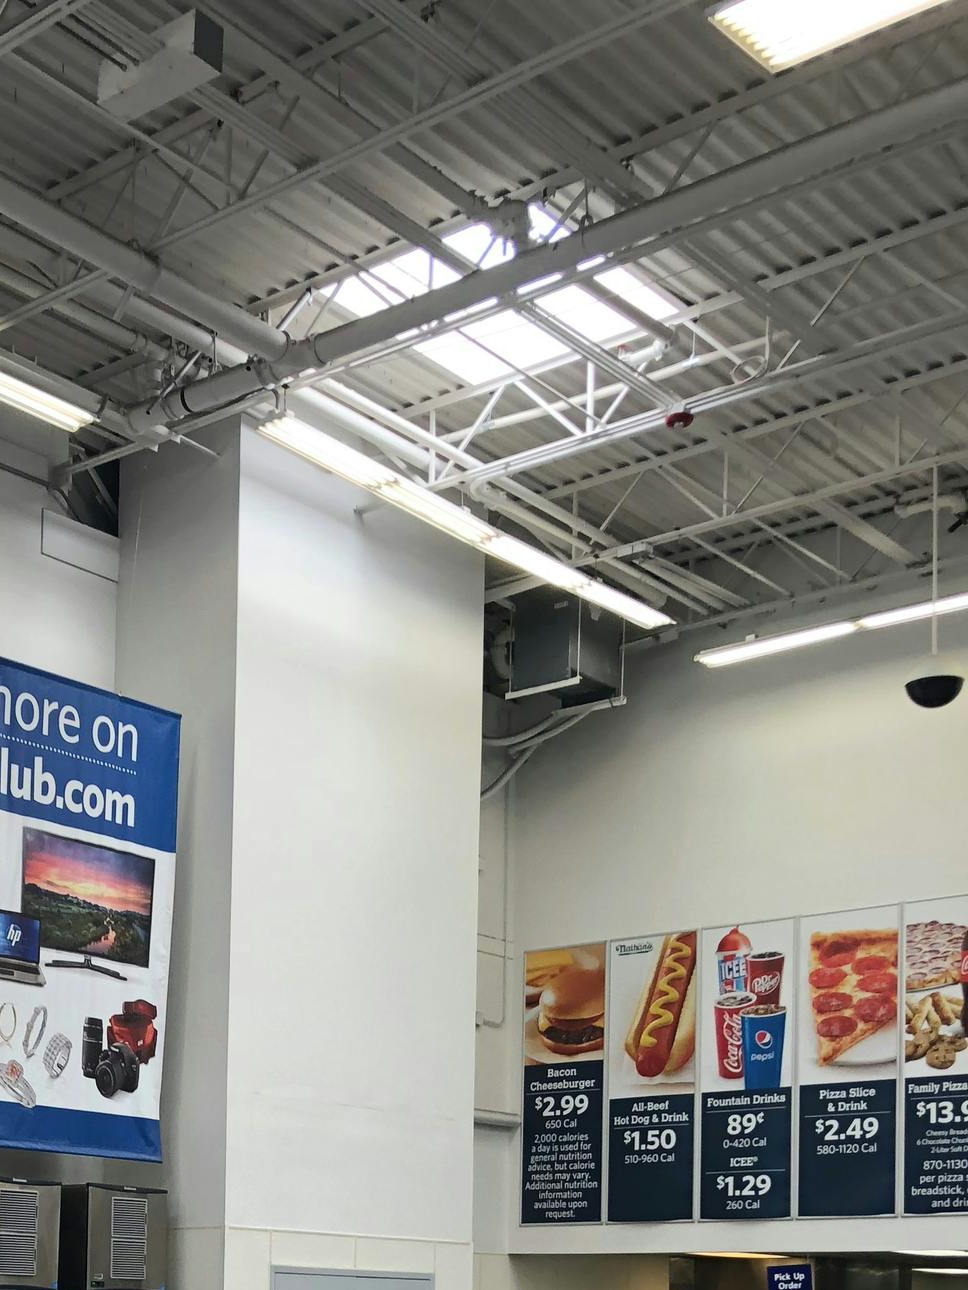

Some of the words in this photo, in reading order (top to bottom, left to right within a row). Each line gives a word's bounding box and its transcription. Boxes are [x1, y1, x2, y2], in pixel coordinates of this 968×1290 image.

[92, 715, 138, 762] on
[6, 924, 22, 947] hp
[750, 1051, 775, 1062] pepsi
[547, 1068, 577, 1078] Bacon
[530, 1078, 596, 1092] Cheeseburger
[908, 1082, 940, 1095] Family
[942, 1081, 968, 1092] Pizza
[819, 1089, 847, 1100] Pizza
[848, 1086, 876, 1098] Slice
[535, 1095, 589, 1117] $2.99
[632, 1101, 669, 1112] All-Beef
[707, 1094, 751, 1108] Fountain
[752, 1093, 786, 1105] Drinks
[827, 1102, 836, 1112] &
[837, 1100, 868, 1112] Drink
[545, 1120, 562, 1129] 650
[563, 1119, 578, 1129] Cal
[613, 1116, 630, 1126] Hot
[631, 1115, 650, 1126] Dog
[651, 1114, 660, 1123] &
[661, 1112, 689, 1123] Drink
[727, 1111, 765, 1136] 89¢
[815, 1117, 879, 1141] $2.49
[534, 1133, 558, 1144] 2,000
[558, 1133, 589, 1142] calories
[623, 1129, 677, 1151] $1.50
[722, 1138, 751, 1149] 0-420
[752, 1137, 767, 1148] Cal
[921, 1138, 950, 1146] Chocolate
[537, 1144, 551, 1154] day
[552, 1144, 559, 1152] is
[560, 1143, 579, 1151] used
[580, 1143, 591, 1151] for
[816, 1144, 859, 1155] 580-1120
[861, 1142, 877, 1153] Cal
[530, 1153, 558, 1163] general
[558, 1152, 593, 1161] nutrition
[624, 1153, 659, 1165] 510-960
[660, 1152, 675, 1162] Cal
[528, 1162, 553, 1172] advice,
[554, 1162, 568, 1171] but
[569, 1161, 596, 1170] calorie
[923, 1159, 968, 1171] 870-1130
[531, 1172, 553, 1181] needs
[554, 1173, 571, 1182] may
[573, 1172, 591, 1182] vary.
[919, 1174, 936, 1185] per
[937, 1173, 964, 1184] pizza
[525, 1181, 563, 1190] Additional
[564, 1180, 598, 1189] nutrition
[716, 1174, 772, 1197] $1.29
[911, 1185, 965, 1197] breadstick,
[538, 1191, 583, 1199] information
[533, 1200, 567, 1209] available
[567, 1201, 588, 1210] upon
[726, 1200, 744, 1210] 260
[745, 1199, 761, 1210] Cal
[931, 1198, 951, 1209] and
[545, 1210, 576, 1220] request.
[774, 1273, 792, 1282] Pick
[793, 1272, 806, 1282] Up
[778, 1281, 802, 1290] Order
